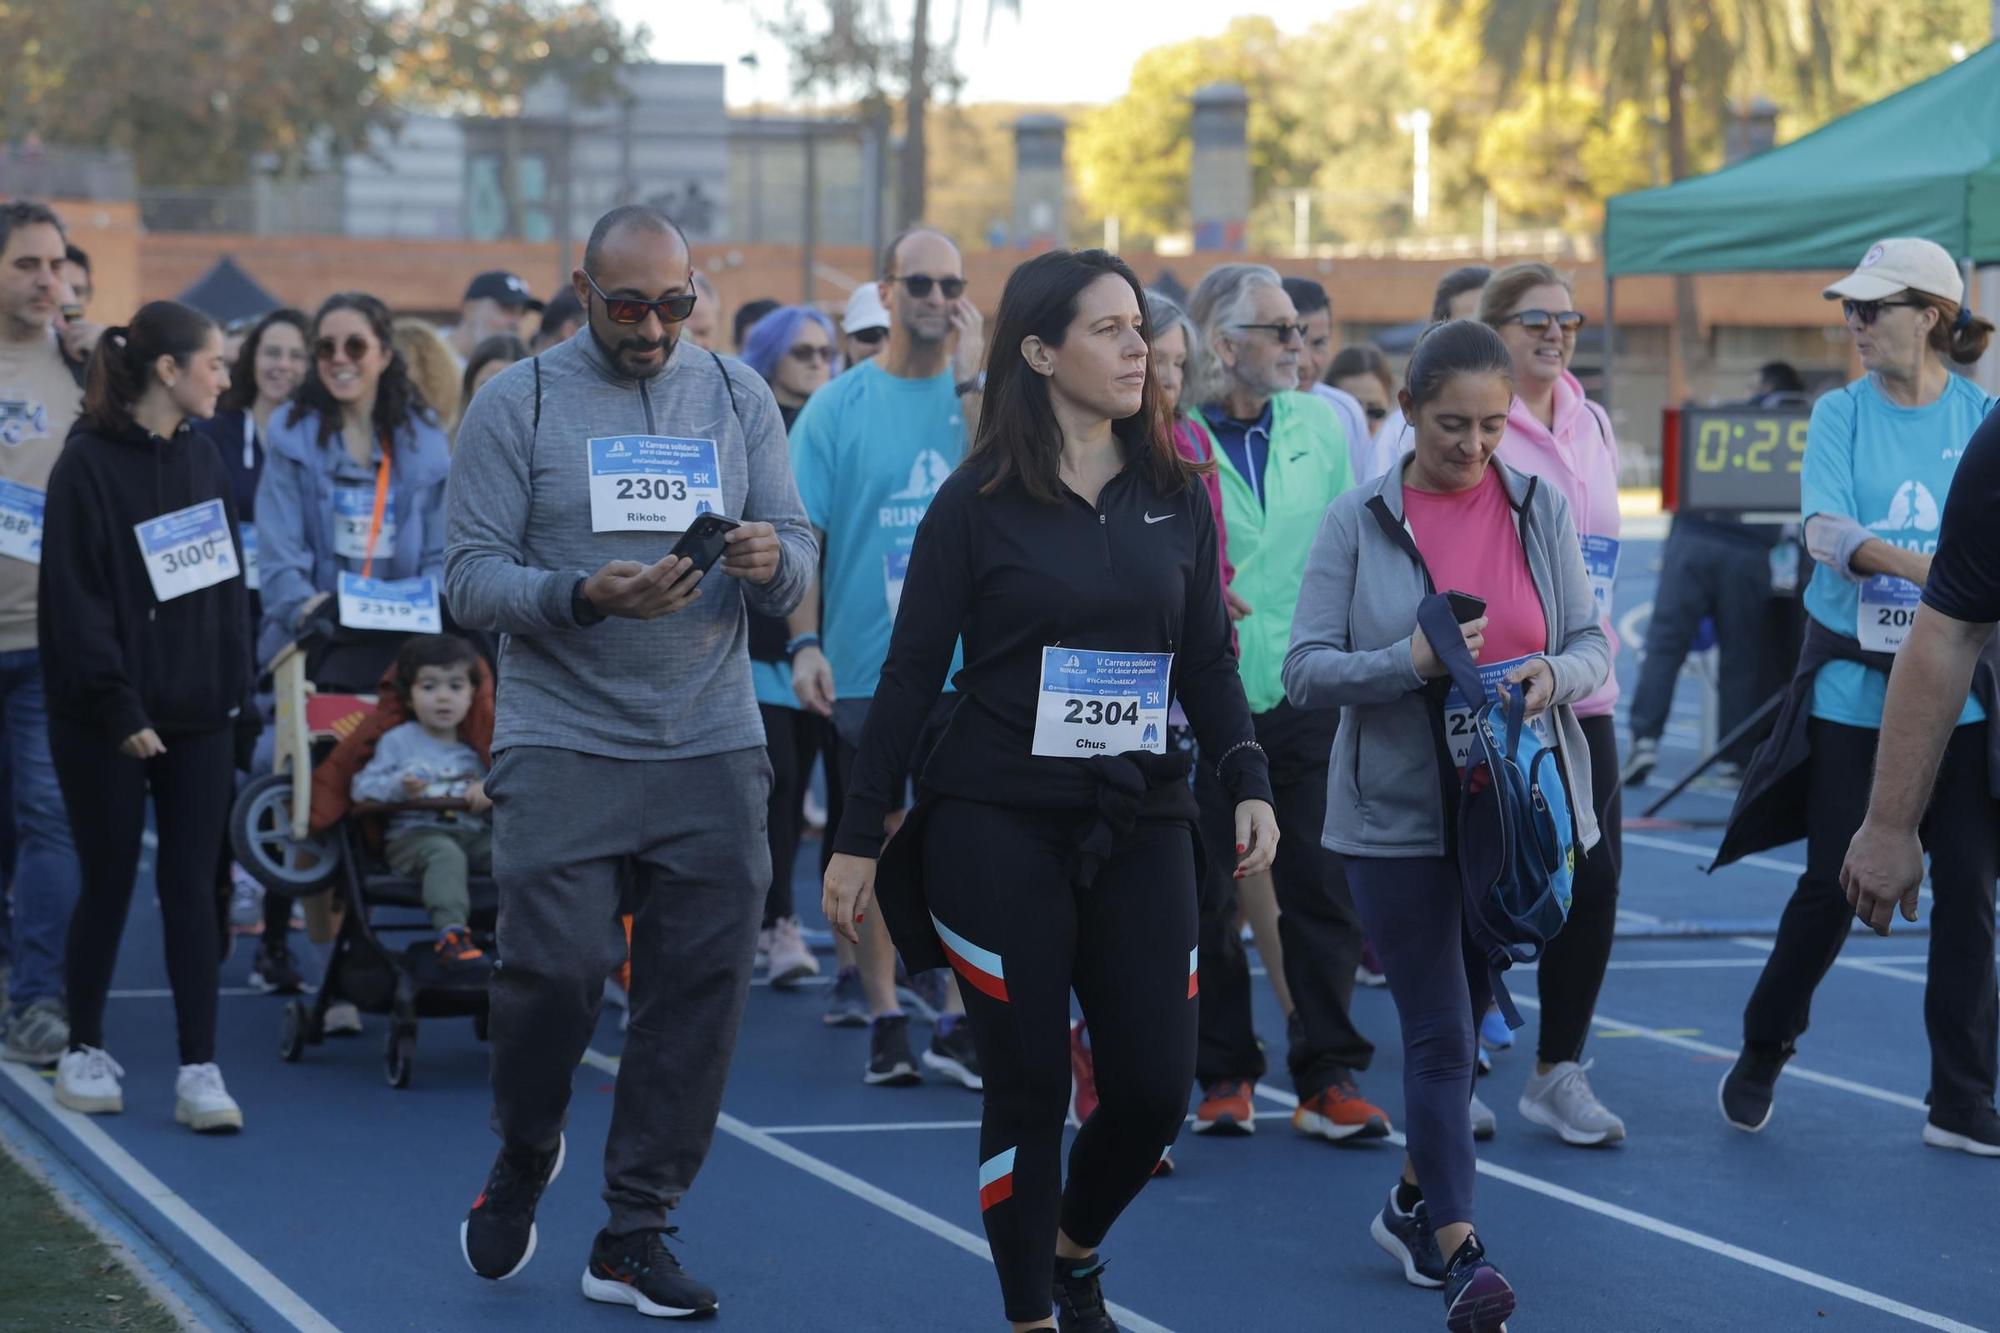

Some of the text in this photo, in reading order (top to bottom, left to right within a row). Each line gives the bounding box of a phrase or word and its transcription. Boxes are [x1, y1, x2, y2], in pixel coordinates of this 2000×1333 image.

[693, 472, 710, 484] 5K
[616, 478, 687, 501] 2303
[627, 512, 667, 523] Rikobe
[1096, 658, 1157, 667] V Carrera solidaria
[1146, 691, 1160, 705] 5K
[1063, 698, 1139, 726] 2304
[1075, 738, 1107, 749] Chus
